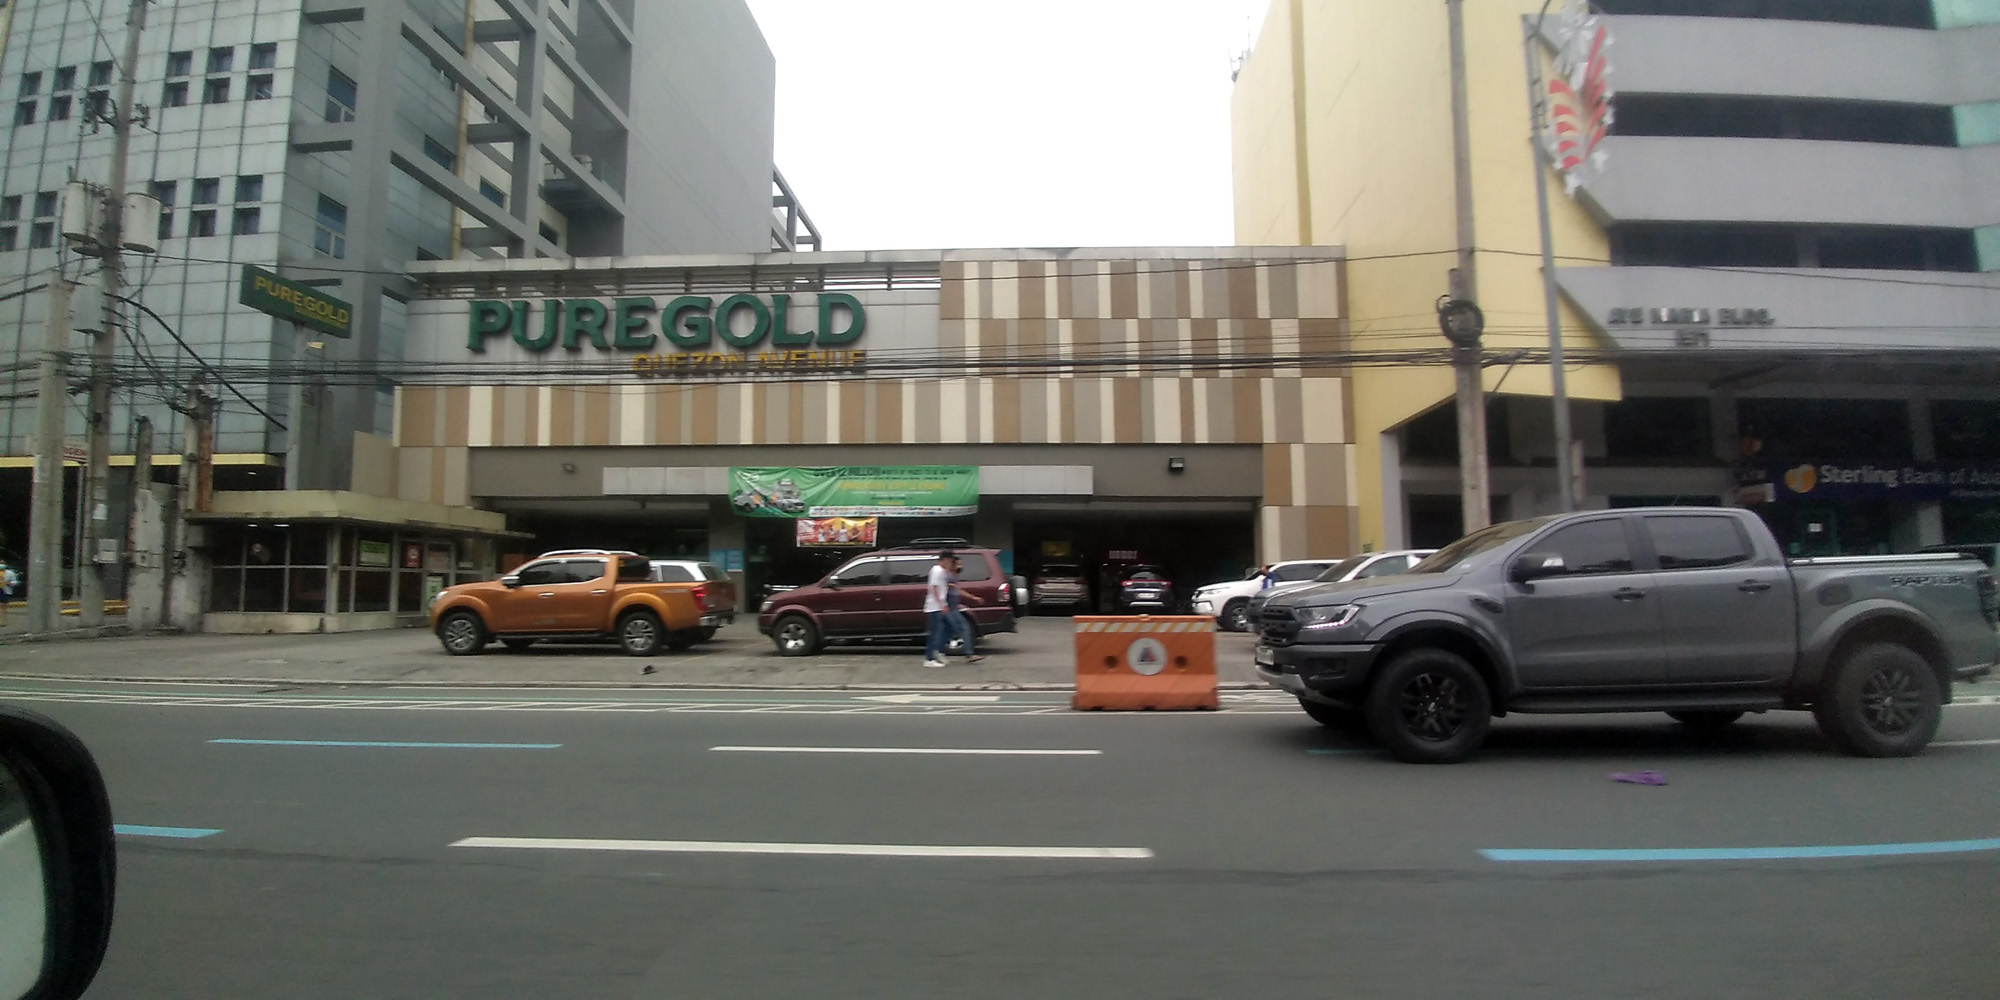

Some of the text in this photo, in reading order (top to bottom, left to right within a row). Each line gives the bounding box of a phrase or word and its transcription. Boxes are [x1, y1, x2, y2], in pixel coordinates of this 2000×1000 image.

[255, 275, 349, 323] PUREGOLD
[467, 293, 867, 352] PUREGOLD
[632, 350, 867, 374] QUEZON AVENUE
[1820, 464, 1899, 487] Sterling
[1903, 467, 1943, 484] Bank
[1950, 467, 1966, 484] of
[1889, 574, 1966, 588] RAPTOR
